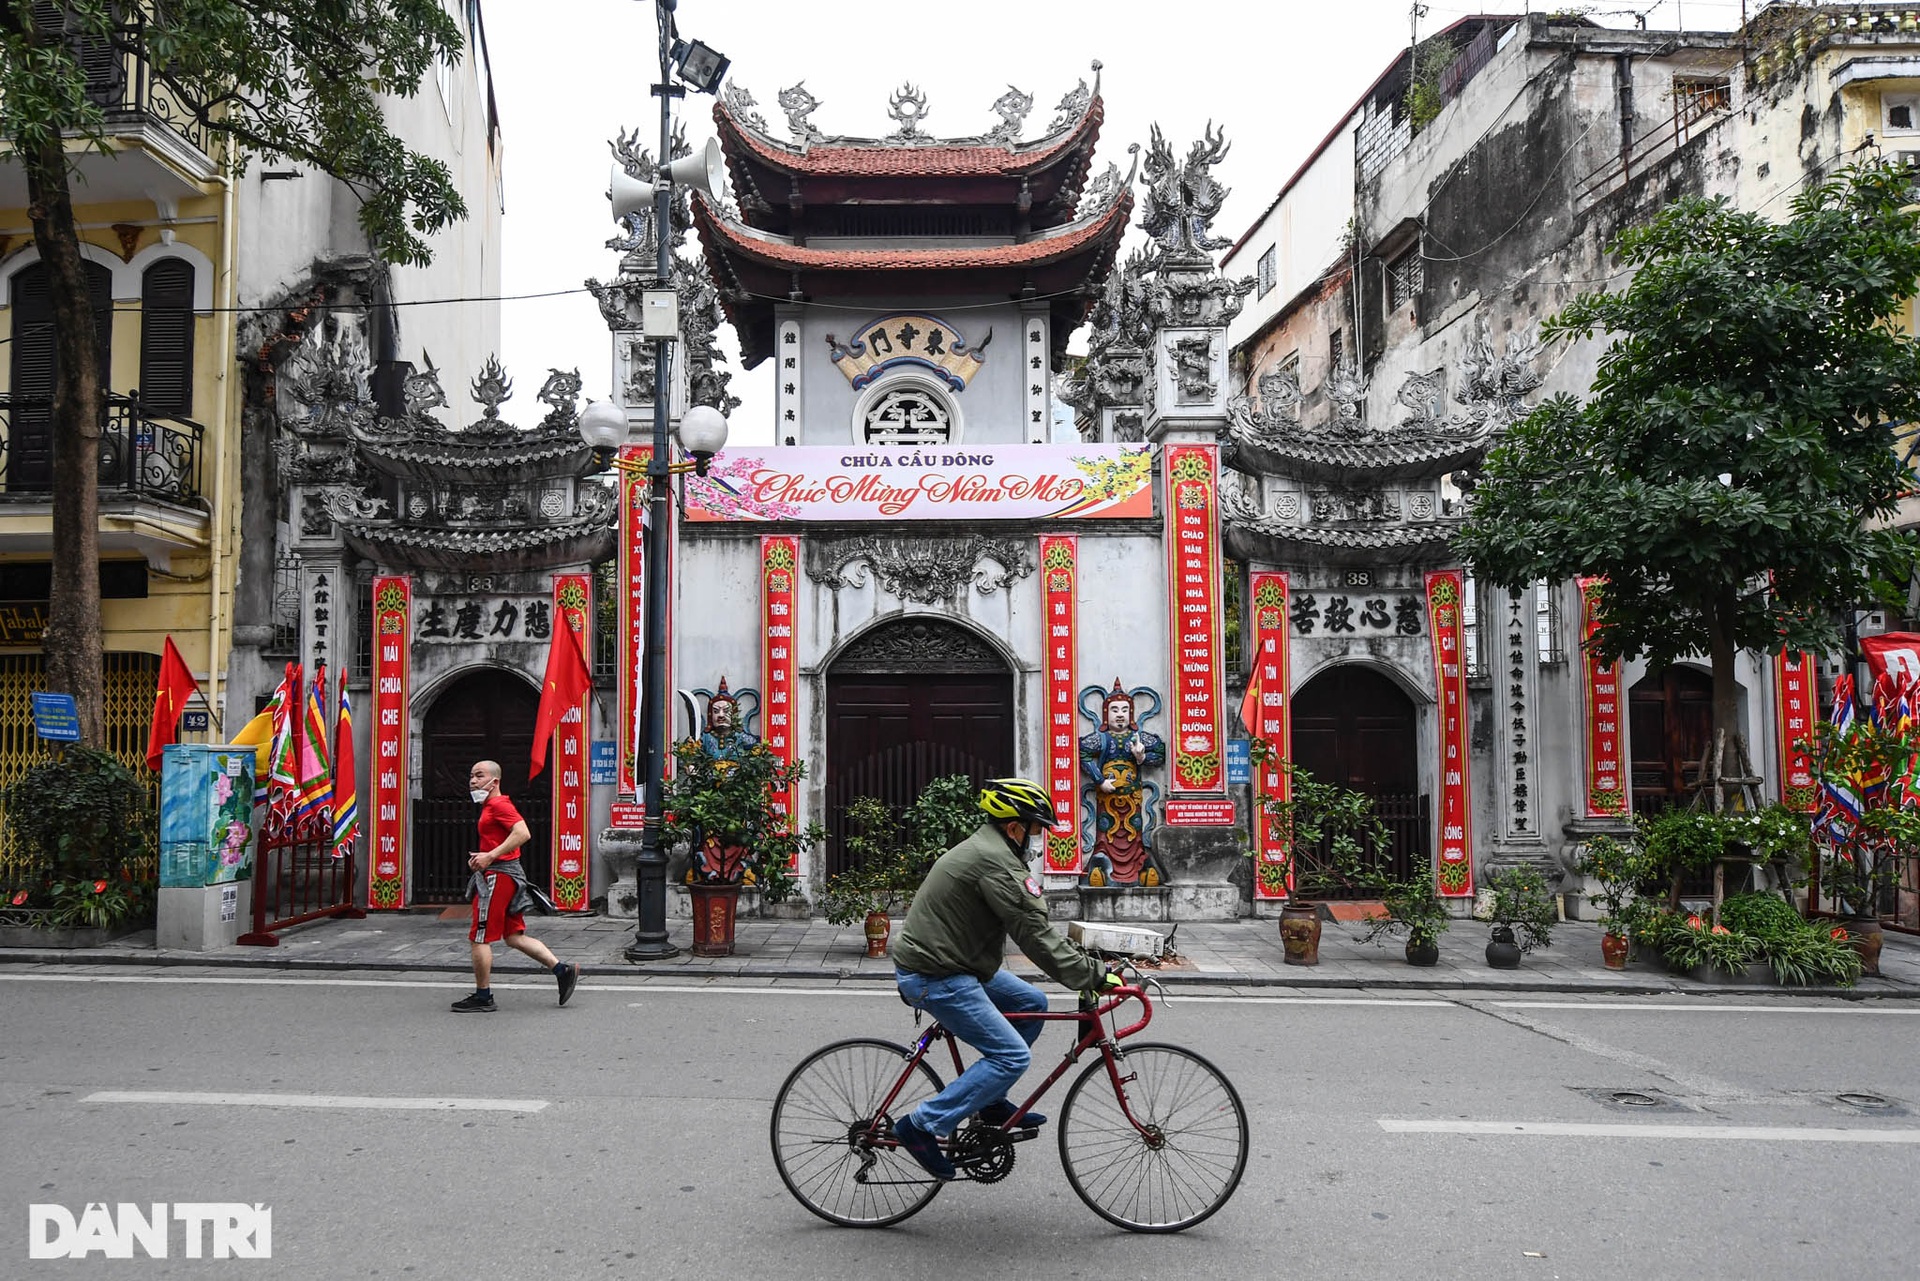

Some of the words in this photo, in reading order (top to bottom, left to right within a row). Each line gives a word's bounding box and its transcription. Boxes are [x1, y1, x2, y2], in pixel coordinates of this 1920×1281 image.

[840, 452, 893, 467] CHÙA
[897, 449, 937, 467] CẦU
[942, 451, 994, 467] ĐÔNG
[750, 469, 827, 503] Chúc
[825, 474, 921, 516] Mừng
[918, 473, 1006, 503] Năm
[999, 474, 1084, 503] Mới
[1184, 515, 1201, 525] ĐÓN
[1181, 530, 1204, 540] CHÀO
[1184, 544, 1202, 555] NĂM
[1185, 573, 1203, 584] NHÀ
[1348, 572, 1370, 586] 38
[1185, 587, 1204, 598] NHÀ
[771, 600, 788, 616] TIẾNG
[1183, 604, 1207, 613] HOAN
[769, 623, 791, 638] CHUÔNG
[1184, 632, 1208, 643] CHÚC
[383, 641, 399, 662] MÁI
[1184, 649, 1208, 660] TỤNG
[773, 669, 785, 682] NGA
[1053, 669, 1070, 685] TỤNG
[380, 673, 402, 694] CHÙA
[1189, 679, 1205, 687] VUI
[1595, 684, 1615, 695] THANH
[1598, 702, 1614, 714] PHÚC
[187, 715, 206, 727] 42
[381, 709, 399, 726] CHE
[1054, 713, 1071, 726] VANG
[1182, 721, 1213, 732] ĐƯỜNG
[1055, 754, 1071, 770] PHÁP
[563, 765, 579, 787] CỦA
[381, 800, 396, 821] DÂN
[381, 832, 395, 858] TỘC
[560, 831, 581, 851] TÔNG
